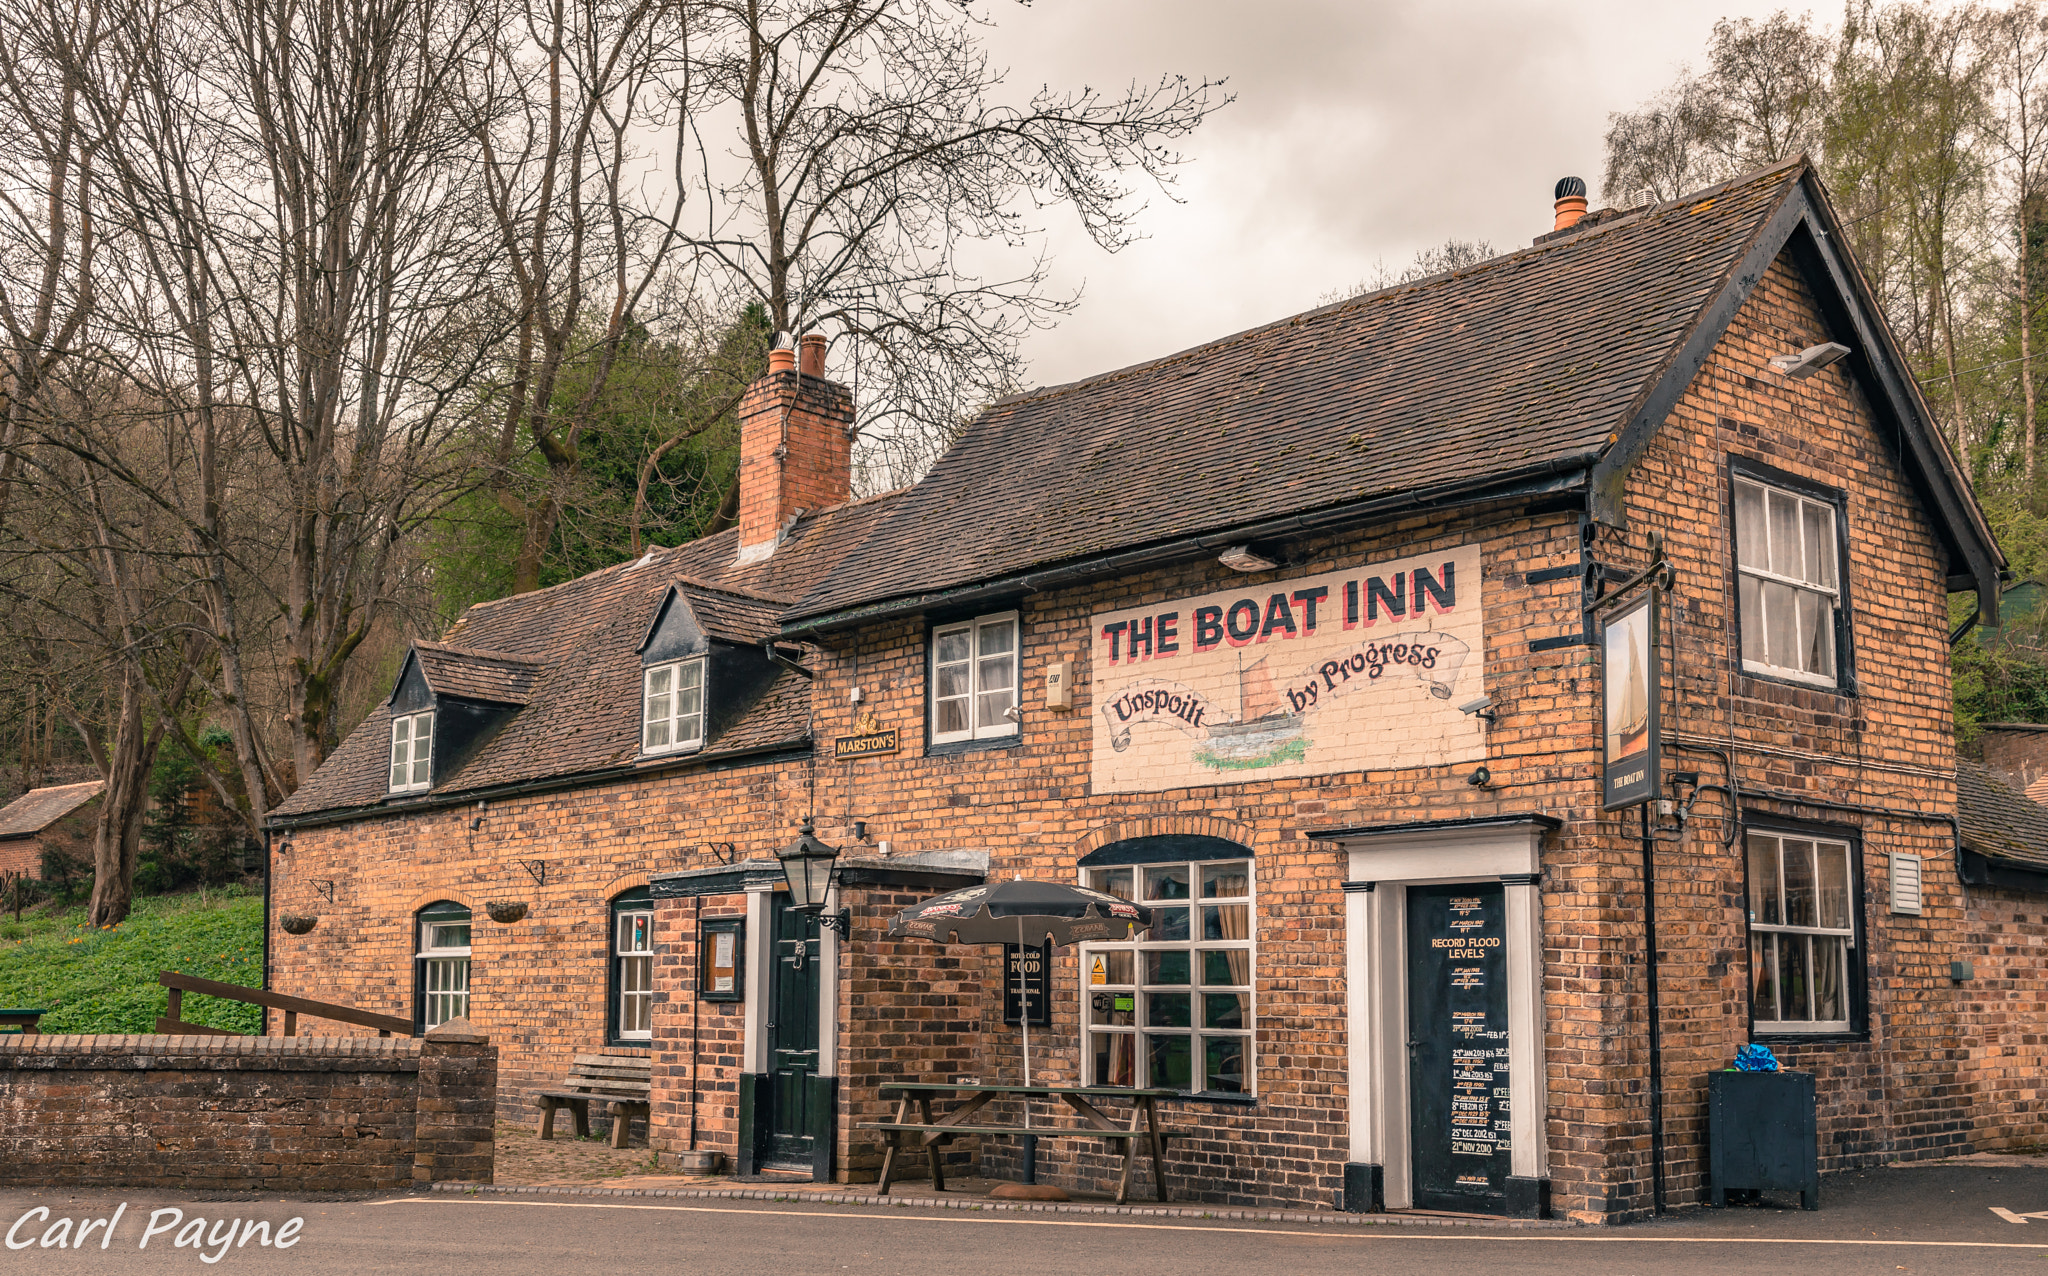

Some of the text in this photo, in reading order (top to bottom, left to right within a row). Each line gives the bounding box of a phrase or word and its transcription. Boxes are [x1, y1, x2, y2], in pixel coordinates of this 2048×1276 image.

[1101, 561, 1455, 666] THE BOAT INN
[1286, 642, 1441, 712] by Progress
[1112, 688, 1206, 728] Unspoilt
[837, 735, 895, 754] MARSTON'S
[1613, 769, 1645, 789] THE BOAT INN
[1432, 937, 1500, 948] RECORD FLOOD
[1449, 949, 1485, 959] LEVELS
[1486, 1031, 1499, 1039] FEB
[1494, 1062, 1503, 1070] FEB
[1460, 1070, 1471, 1078] JAN
[1462, 1129, 1473, 1138] DEC
[1463, 1142, 1475, 1152] NOV
[1476, 1143, 1492, 1154] 2010
